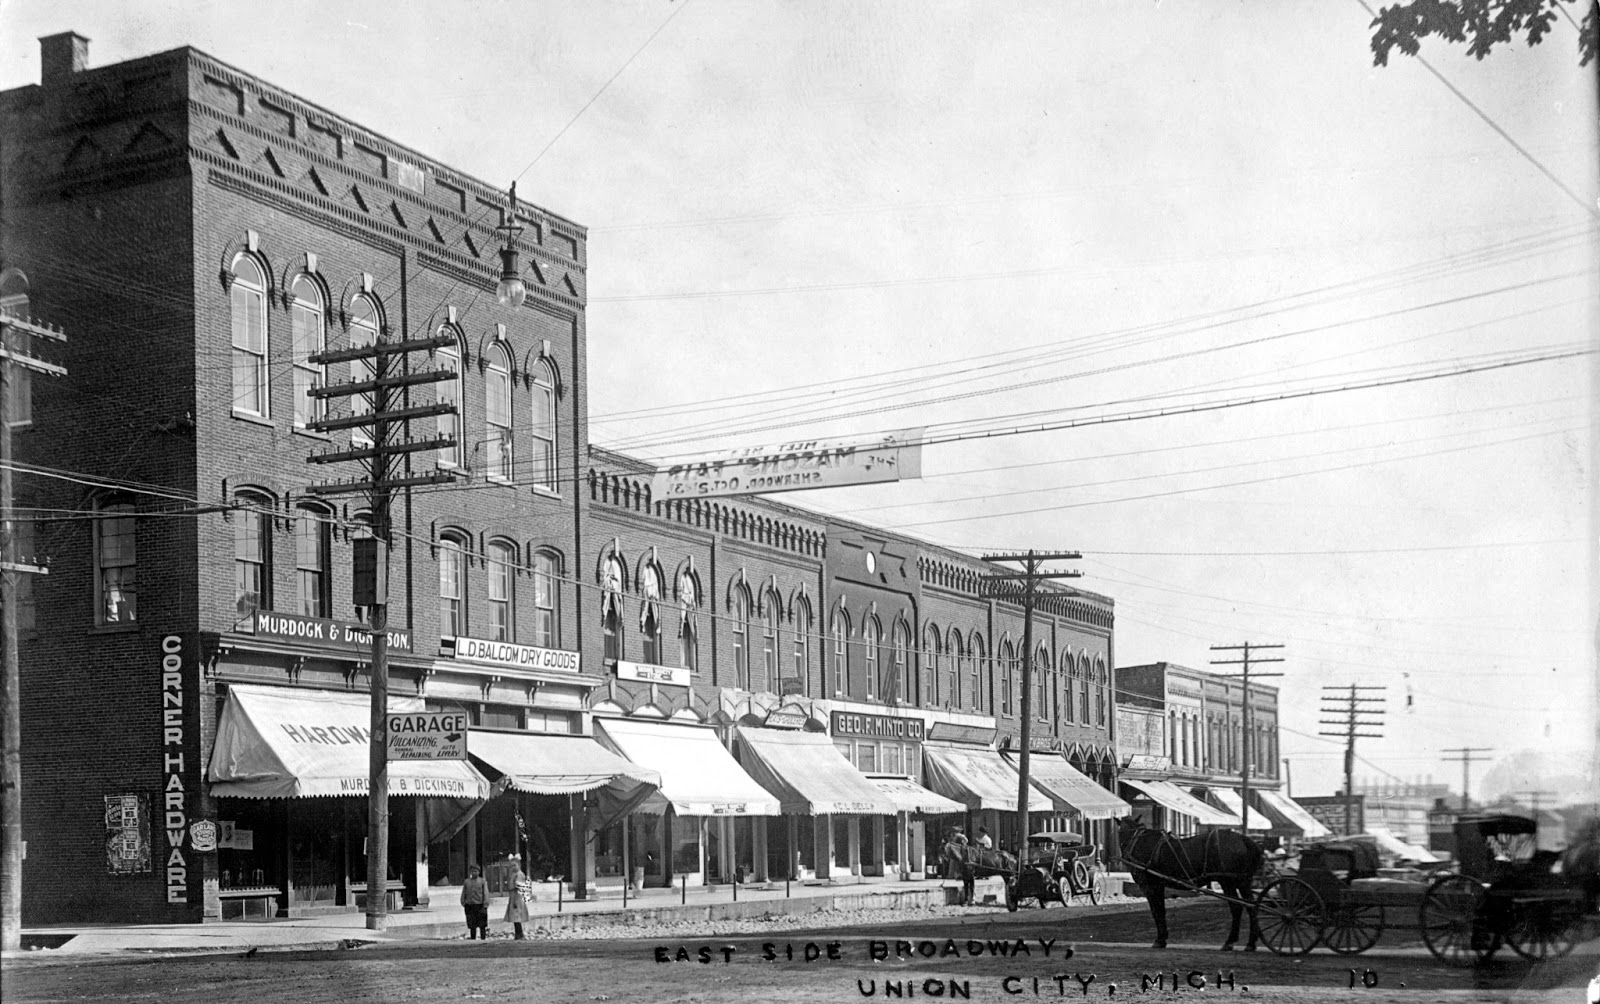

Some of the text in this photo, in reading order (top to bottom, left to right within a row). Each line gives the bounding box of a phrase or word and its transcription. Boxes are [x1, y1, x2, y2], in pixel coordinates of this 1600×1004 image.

[258, 614, 410, 649] MURDOCK & DICSON.
[520, 648, 542, 666] DRY
[543, 651, 578, 670] GOODS.
[280, 723, 371, 745] HARDW
[389, 715, 465, 733] GARAGE
[875, 717, 904, 737] MINTO
[907, 720, 924, 738] CO.
[162, 635, 188, 903] CORNER HARDWARE
[340, 778, 392, 791] MURDK
[415, 779, 465, 792] DICKINSON
